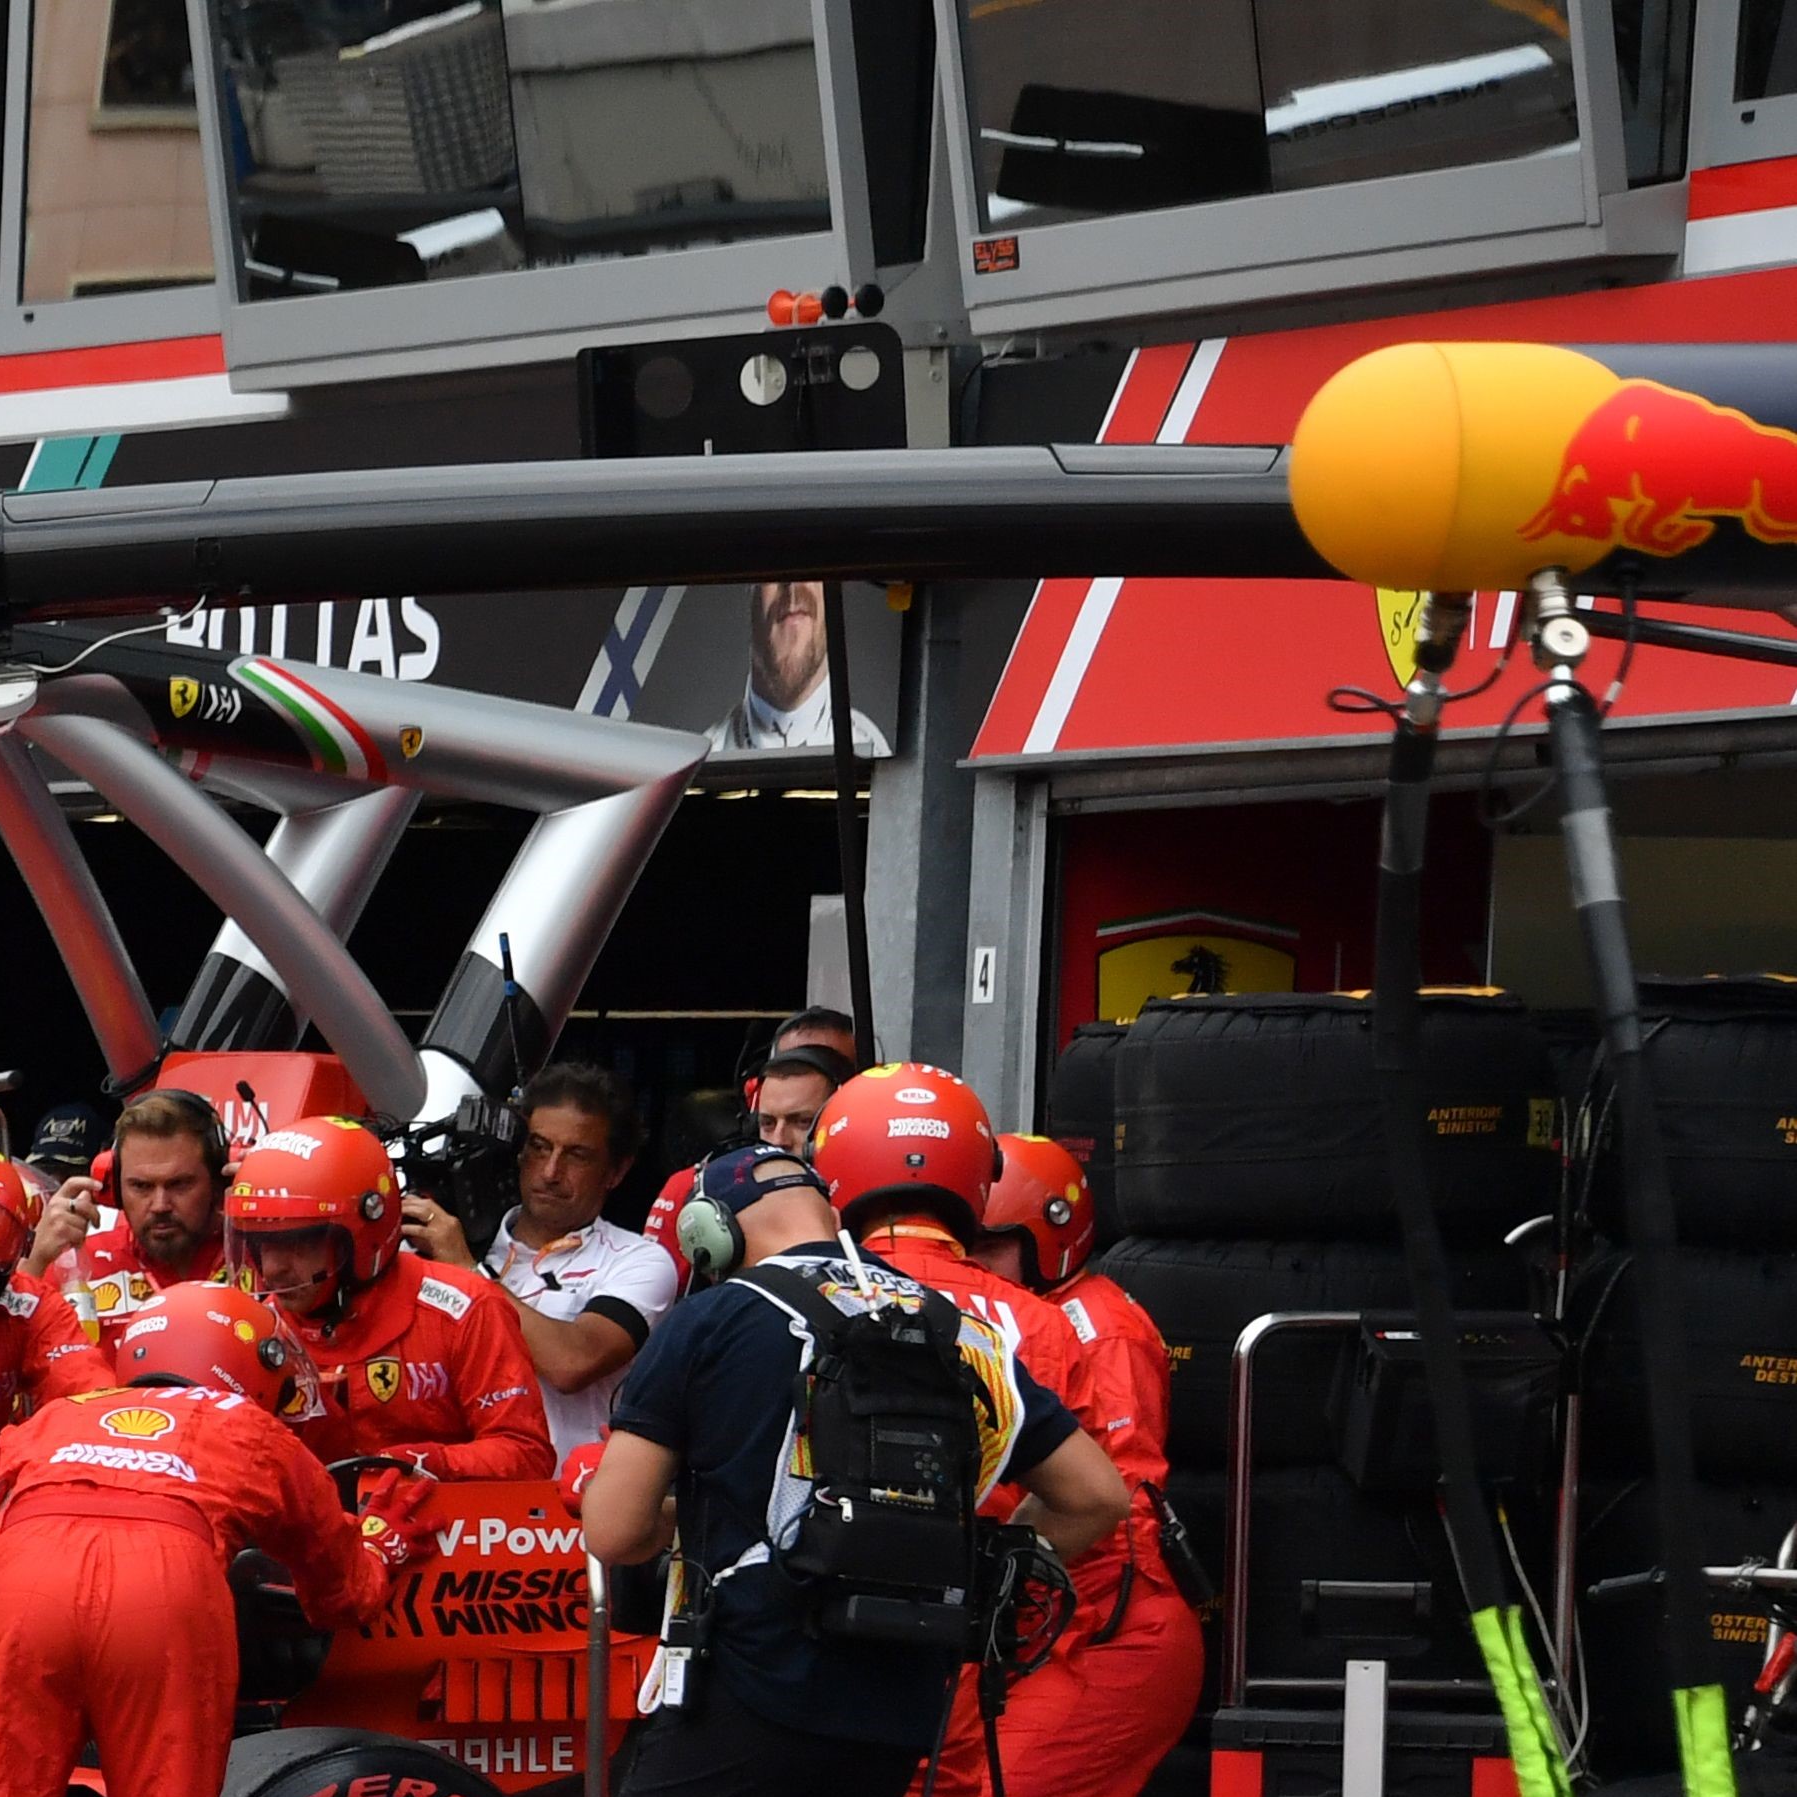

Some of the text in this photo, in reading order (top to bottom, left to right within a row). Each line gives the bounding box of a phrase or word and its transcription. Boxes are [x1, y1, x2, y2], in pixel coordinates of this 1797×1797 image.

[978, 952, 990, 998] 4
[1427, 1106, 1504, 1122] ANTERIORE
[1437, 1120, 1497, 1136] SINISTRA
[211, 1364, 245, 1395] HUBLOT
